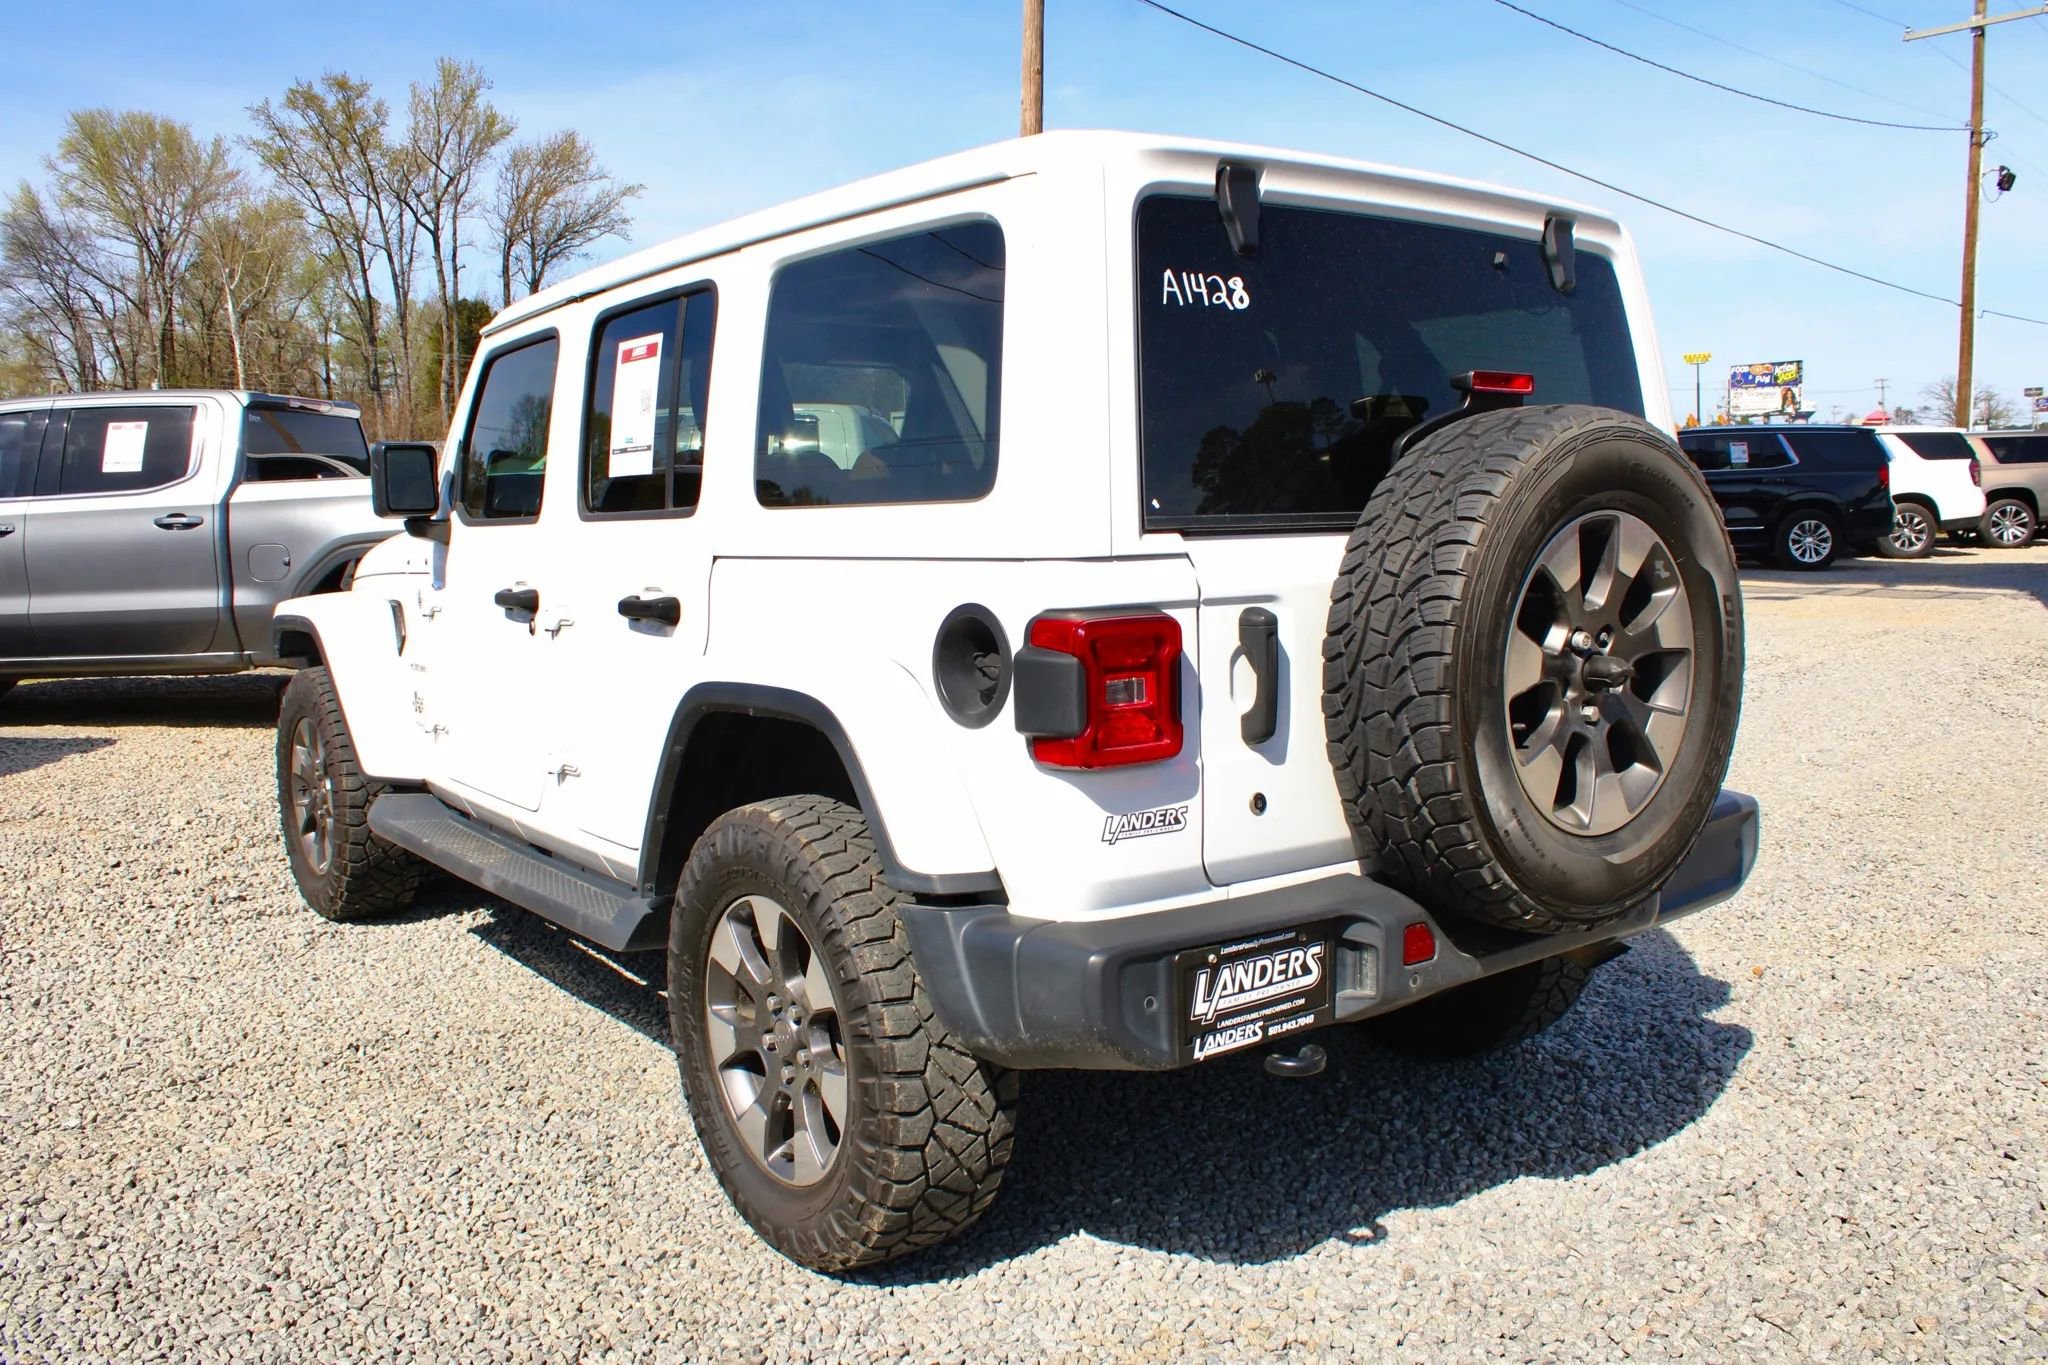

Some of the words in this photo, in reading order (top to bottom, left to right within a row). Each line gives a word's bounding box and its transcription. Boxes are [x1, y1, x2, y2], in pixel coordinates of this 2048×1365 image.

[1163, 268, 1250, 311] A1428
[1101, 806, 1188, 845] LANDERS
[1192, 942, 1324, 1024] LANDERS
[1193, 1021, 1264, 1061] LANDERS
